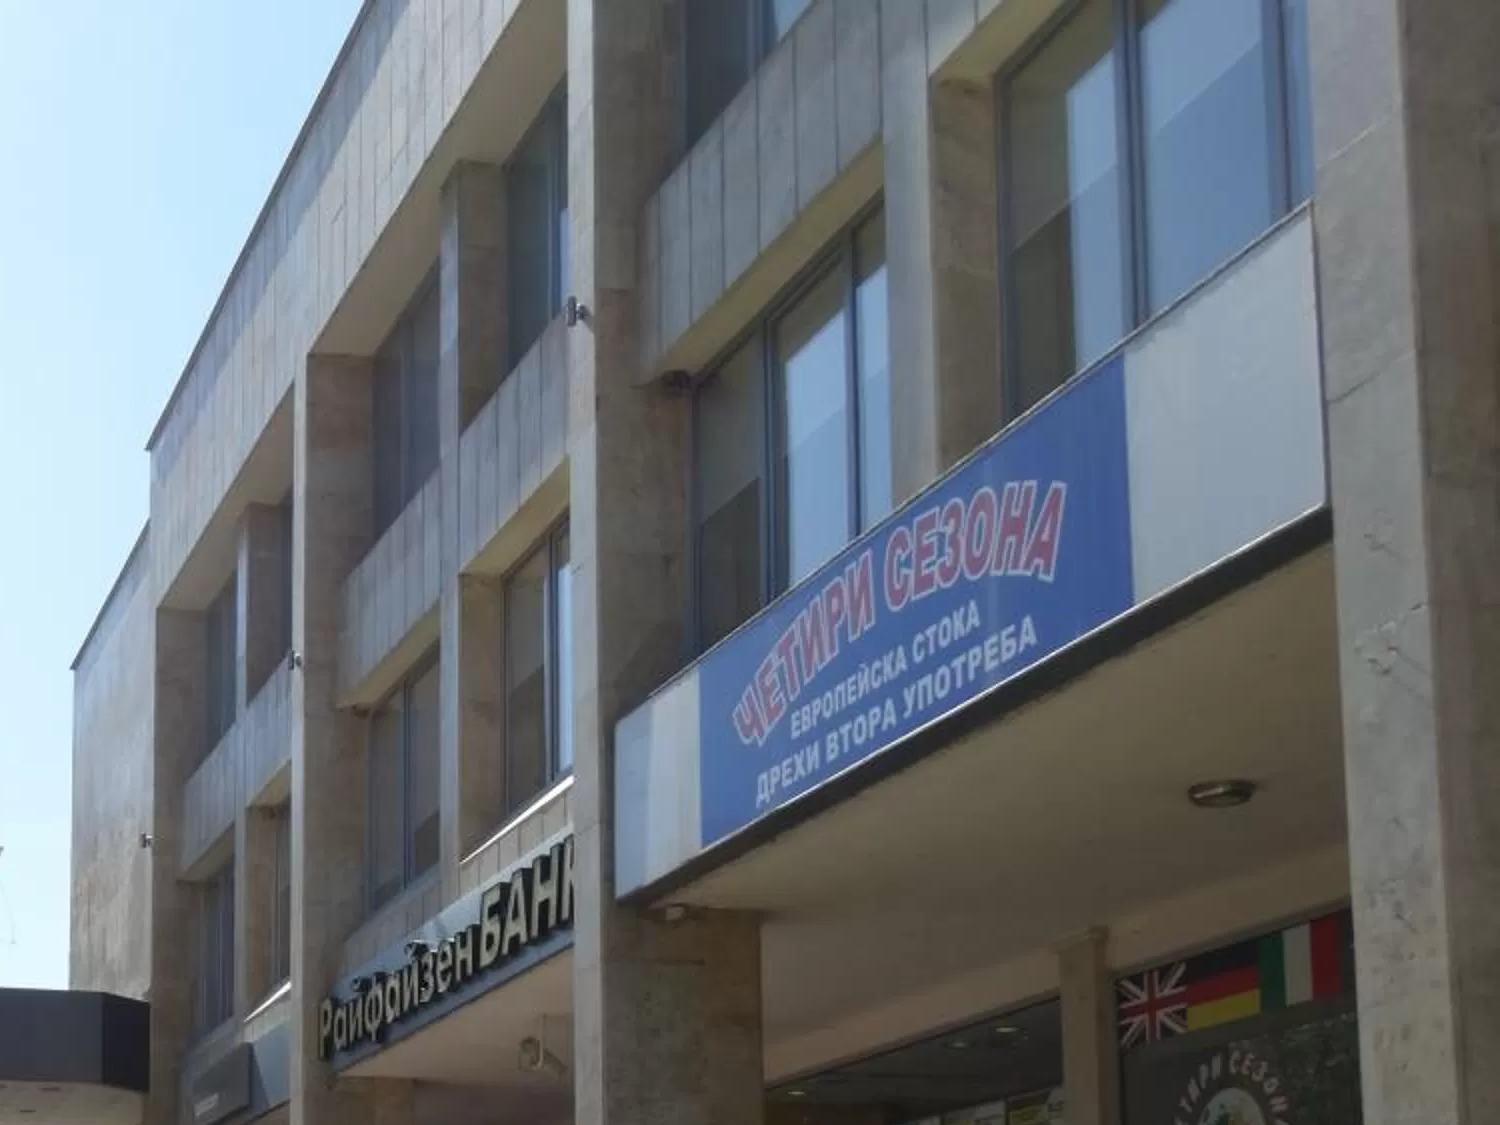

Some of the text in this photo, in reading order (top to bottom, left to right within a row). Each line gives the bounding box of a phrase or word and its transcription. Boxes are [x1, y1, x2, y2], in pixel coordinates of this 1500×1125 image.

[732, 479, 1067, 748] ЧЕТИРИ СЕЗОНА
[790, 600, 981, 740] ЕВРОПЕЙСКА СТОКА
[755, 614, 1037, 809] ДРЕХИ ВТОРА УПОТРЕБА
